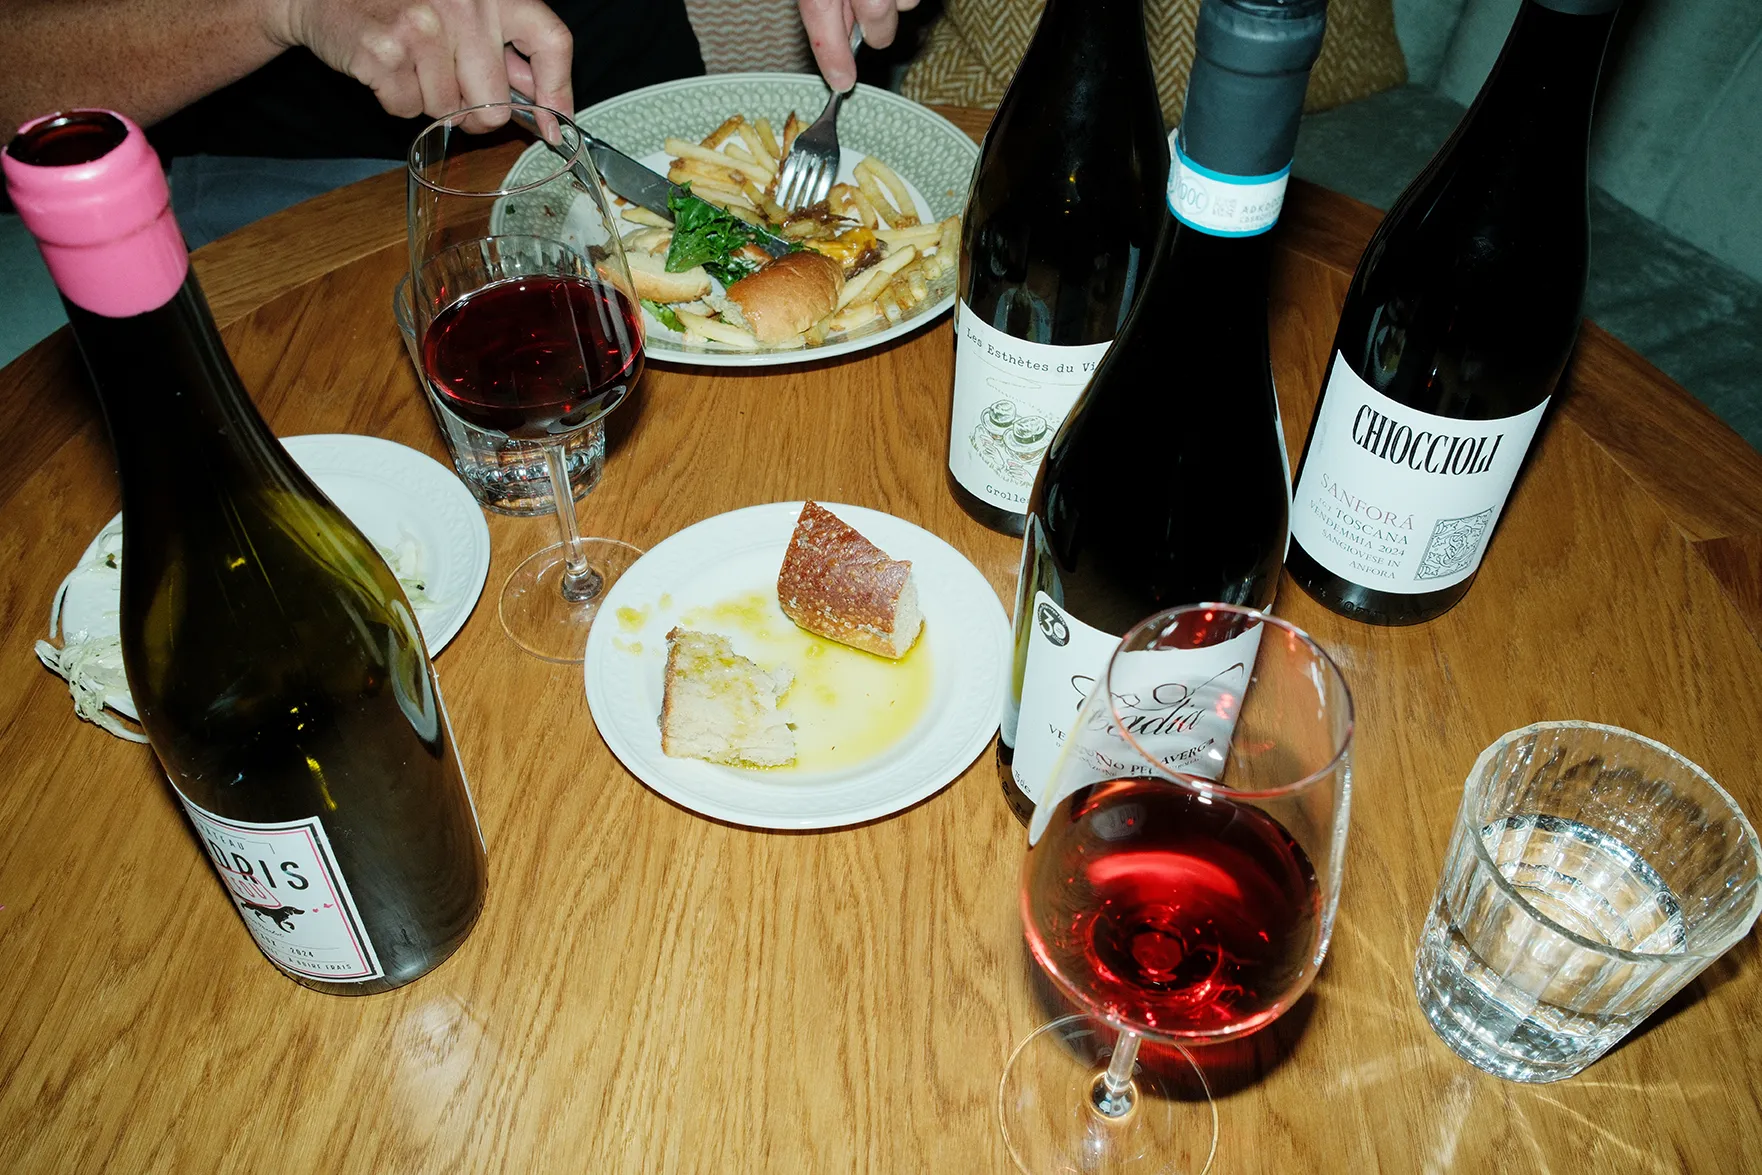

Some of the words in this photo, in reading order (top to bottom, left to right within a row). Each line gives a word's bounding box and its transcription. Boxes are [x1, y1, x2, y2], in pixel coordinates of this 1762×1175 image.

[966, 327, 982, 348] Les
[987, 343, 1049, 373] Esthètes
[1056, 362, 1074, 373] du
[1082, 361, 1097, 373] Vi
[1352, 404, 1504, 476] CHIOCCIOLI
[986, 484, 1029, 504] Grolle
[1320, 473, 1414, 530] SANFORÁ
[1309, 499, 1373, 549] VENDEMMIA
[1378, 544, 1406, 557] 2024
[1335, 506, 1409, 545] TOSCANA
[1321, 529, 1385, 565] SANGIOVESE
[1387, 559, 1402, 569] IN
[1349, 560, 1397, 580] ANFORA
[289, 947, 314, 958] 2024
[325, 964, 352, 972] FRAIS
